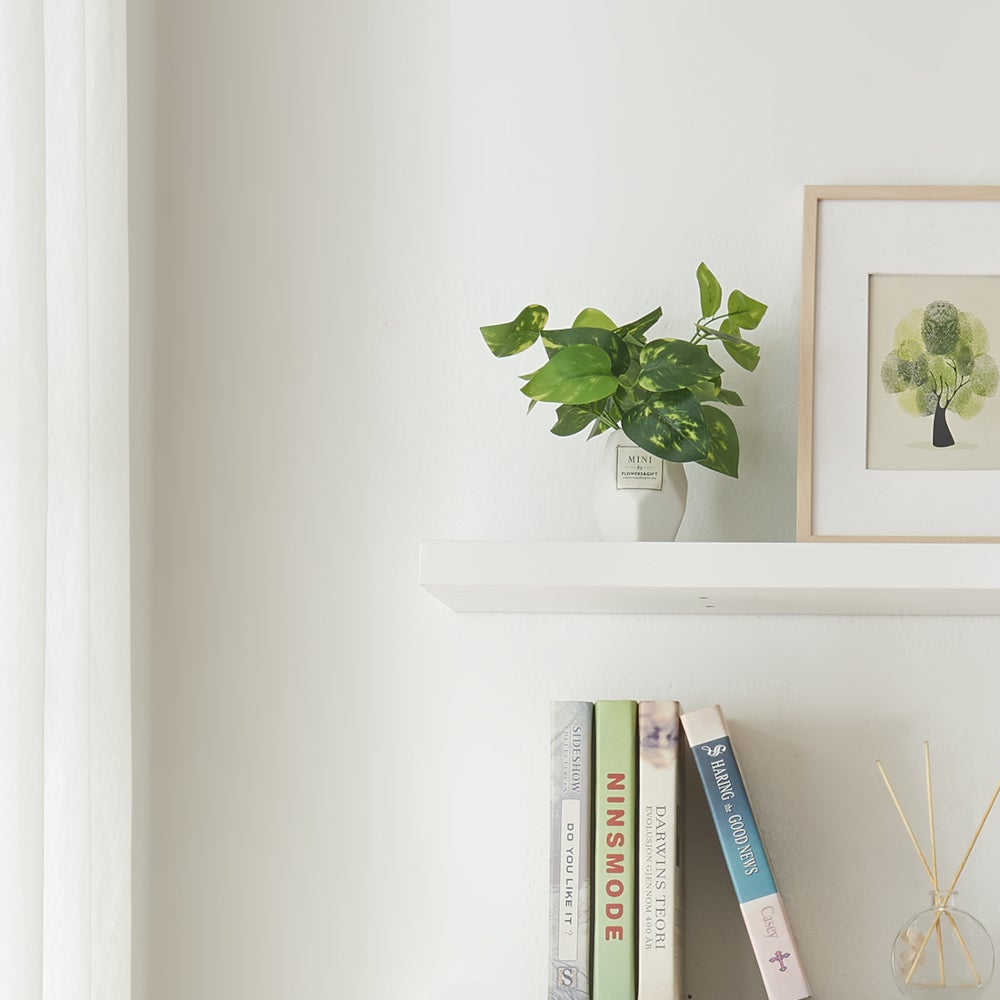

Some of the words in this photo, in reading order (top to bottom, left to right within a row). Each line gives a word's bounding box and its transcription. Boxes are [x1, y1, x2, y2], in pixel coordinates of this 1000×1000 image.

[571, 726, 582, 794] SIDESHOW
[723, 804, 733, 813] the
[566, 823, 574, 842] DO
[645, 806, 653, 862] EVOLUSJON
[728, 814, 749, 845] GOOD
[566, 847, 574, 873] YOU
[605, 773, 626, 941] NINSMODE
[655, 805, 666, 890] DARWINS
[737, 842, 759, 876] NEWS
[565, 878, 573, 907] LIKE
[564, 913, 572, 925] IT
[655, 895, 666, 950] TEORI
[760, 905, 778, 938] Casey
